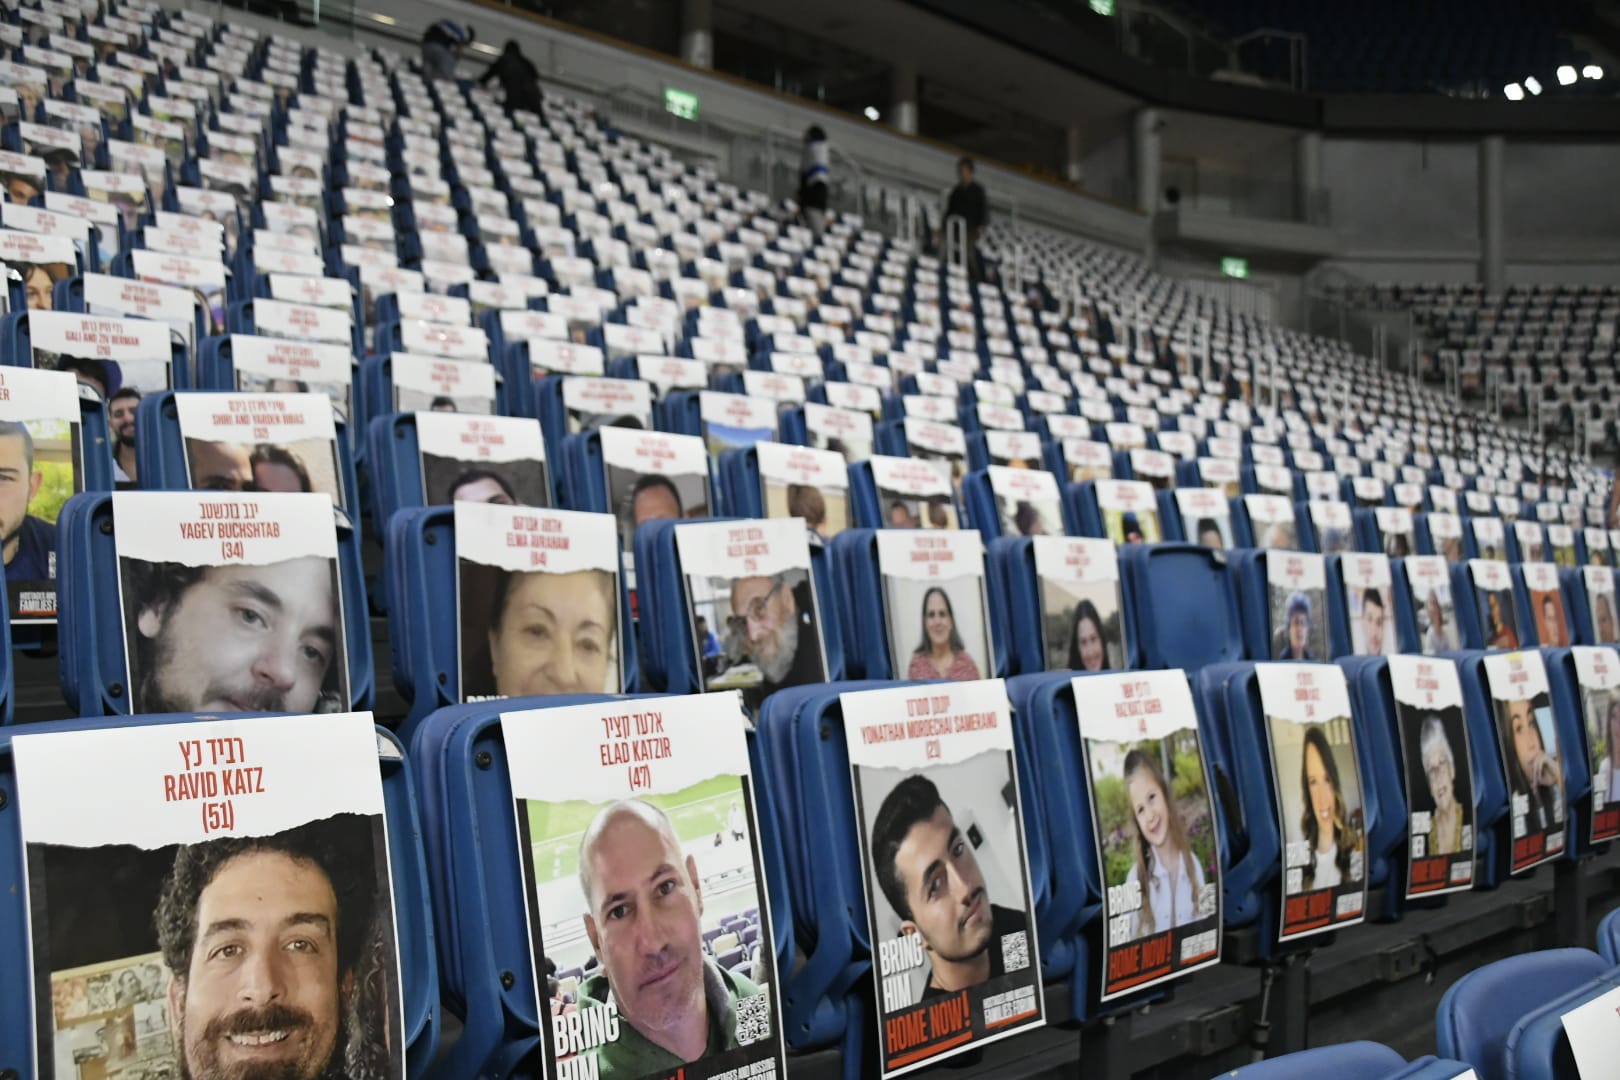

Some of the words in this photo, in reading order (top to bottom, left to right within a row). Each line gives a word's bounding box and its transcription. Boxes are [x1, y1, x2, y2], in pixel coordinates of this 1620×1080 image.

[180, 522, 215, 539] YAGEV
[217, 522, 280, 538] BUCHSHTAB
[221, 541, 244, 560] (34)
[601, 714, 630, 740] קציר
[632, 711, 665, 737] אלעד
[206, 737, 245, 765] רביד
[600, 742, 630, 766] ELAD
[632, 736, 673, 762] KATZIR
[164, 770, 218, 802] RAVID
[222, 766, 265, 796] KATZ
[628, 763, 651, 792] (47)
[202, 799, 235, 834] (51)
[1107, 879, 1142, 918] BRING
[879, 931, 924, 977] BRING
[1109, 943, 1141, 981] HOME
[882, 974, 914, 1014] HIM
[551, 1003, 621, 1058] BRING
[886, 1008, 928, 1055] HOME
[929, 990, 971, 1039] NOW!
